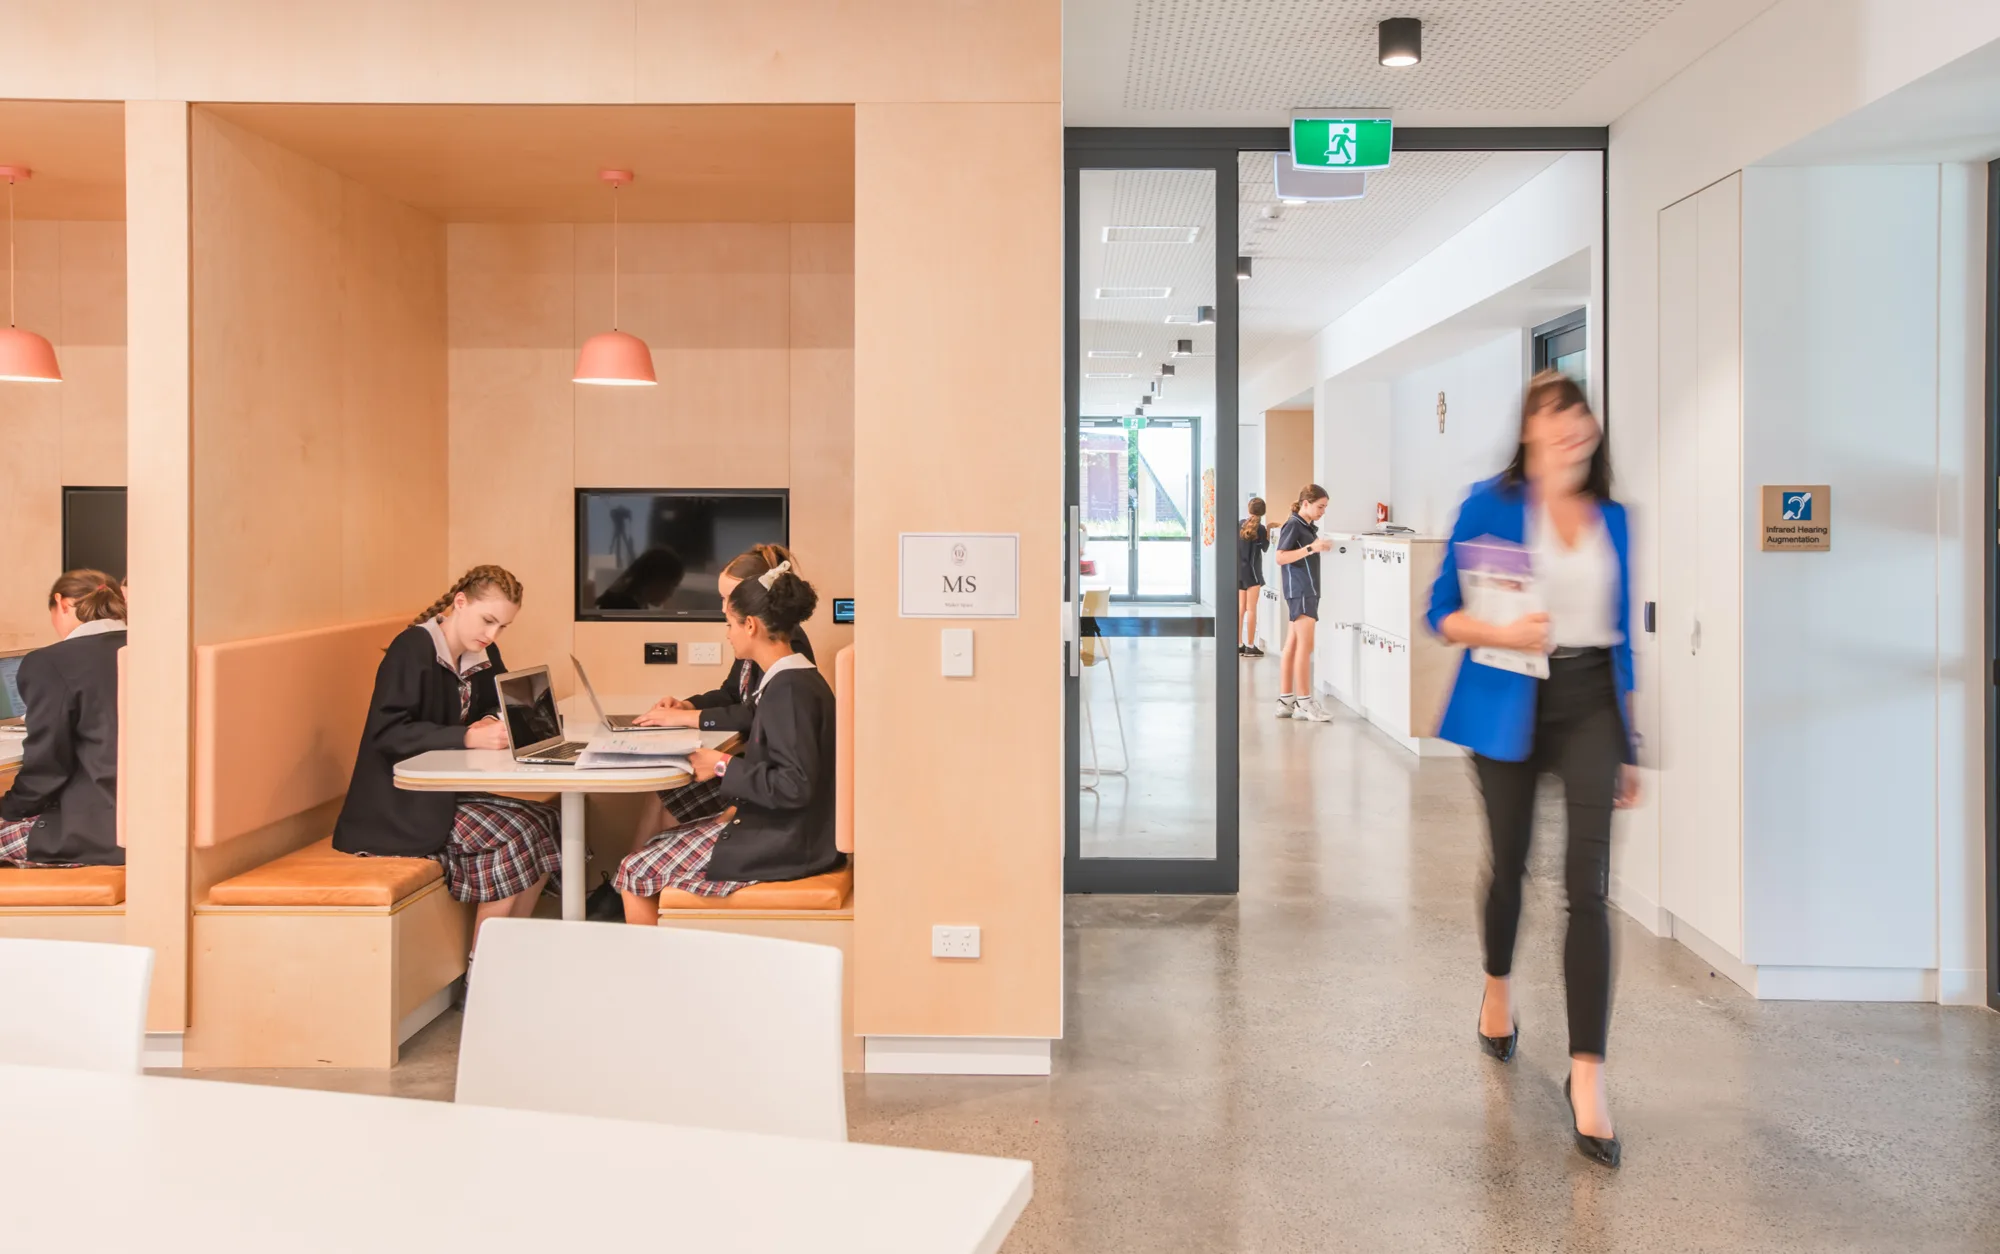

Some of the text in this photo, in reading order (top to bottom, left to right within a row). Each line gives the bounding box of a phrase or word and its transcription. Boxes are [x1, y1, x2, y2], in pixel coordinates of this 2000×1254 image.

[1766, 526, 1828, 536] Infrared Hearing
[1767, 535, 1820, 544] Augmentation
[942, 575, 977, 593] MS
